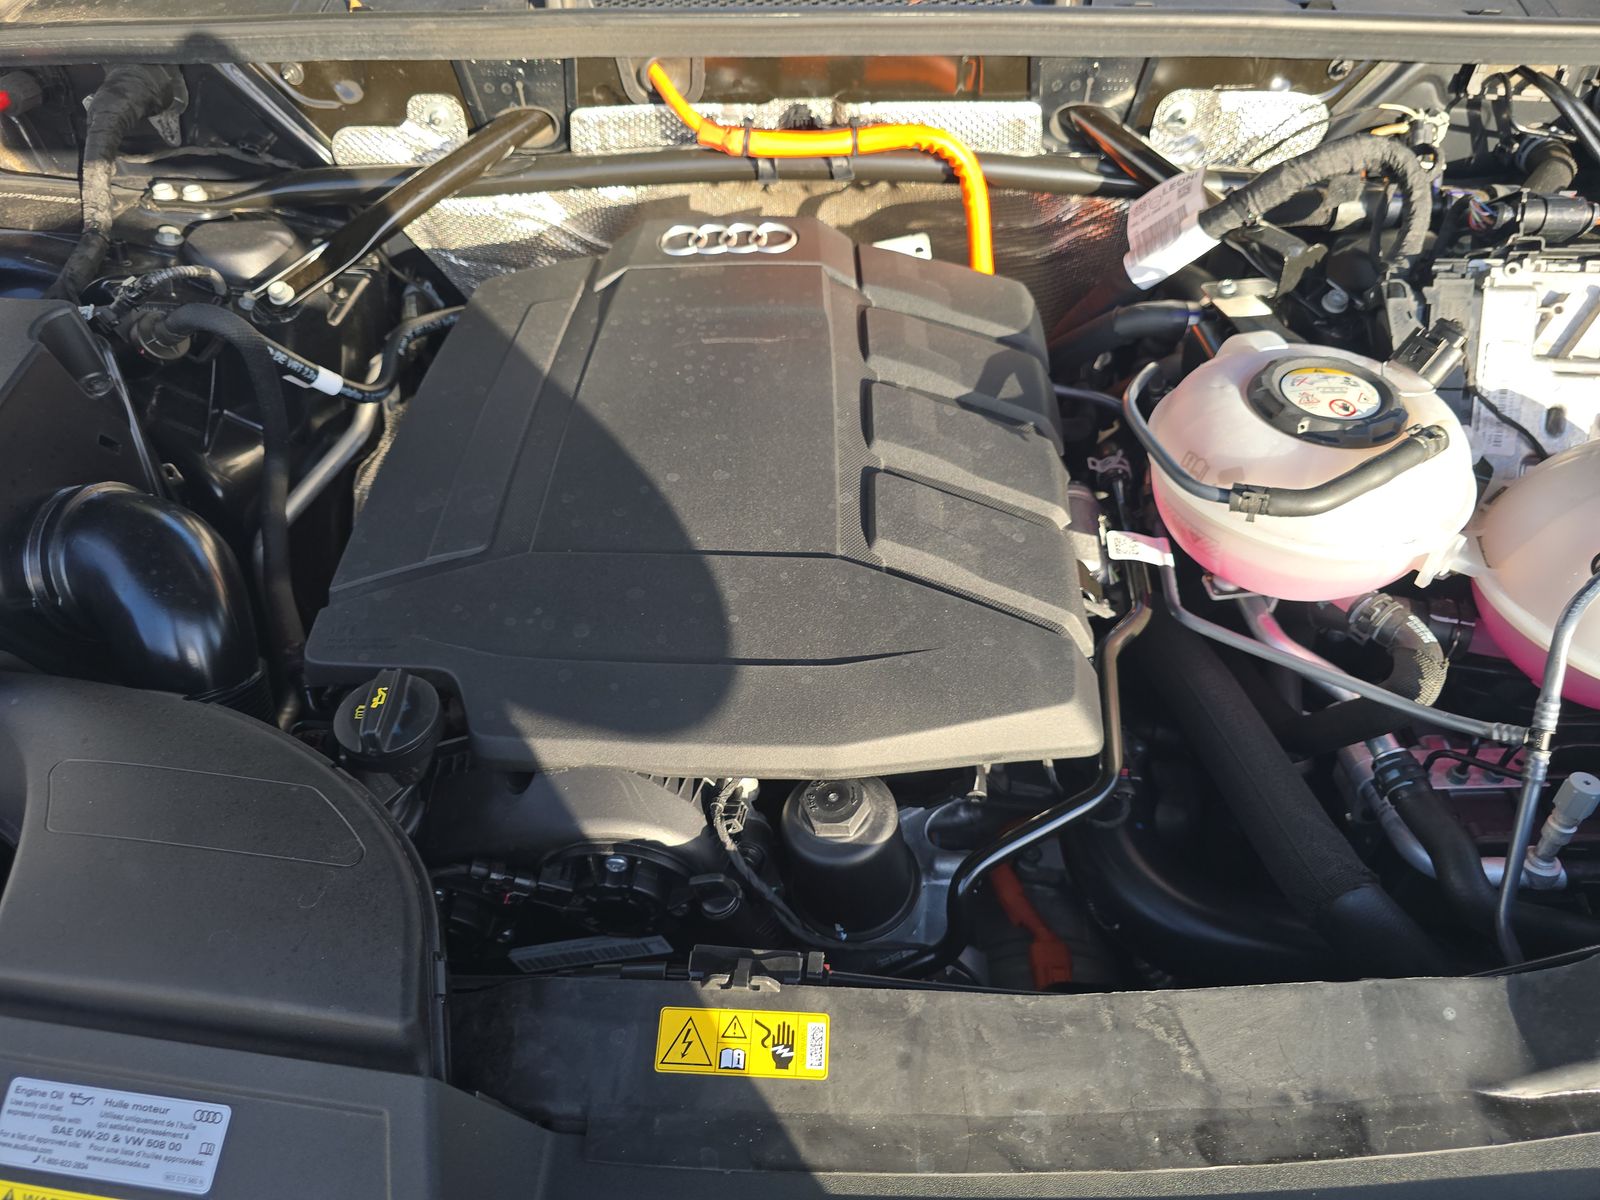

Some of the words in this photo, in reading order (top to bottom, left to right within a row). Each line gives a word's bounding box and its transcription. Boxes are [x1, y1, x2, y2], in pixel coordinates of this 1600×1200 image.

[14, 1085, 48, 1098] Engine
[50, 1090, 65, 1100] Oil
[103, 1097, 129, 1110] Huile
[132, 1102, 171, 1115] moteur
[51, 1124, 74, 1136] SAE
[75, 1128, 110, 1142] 0W-20
[111, 1133, 121, 1143] &
[124, 1135, 145, 1147] VW
[145, 1138, 167, 1150] 508
[167, 1141, 182, 1152] 00
